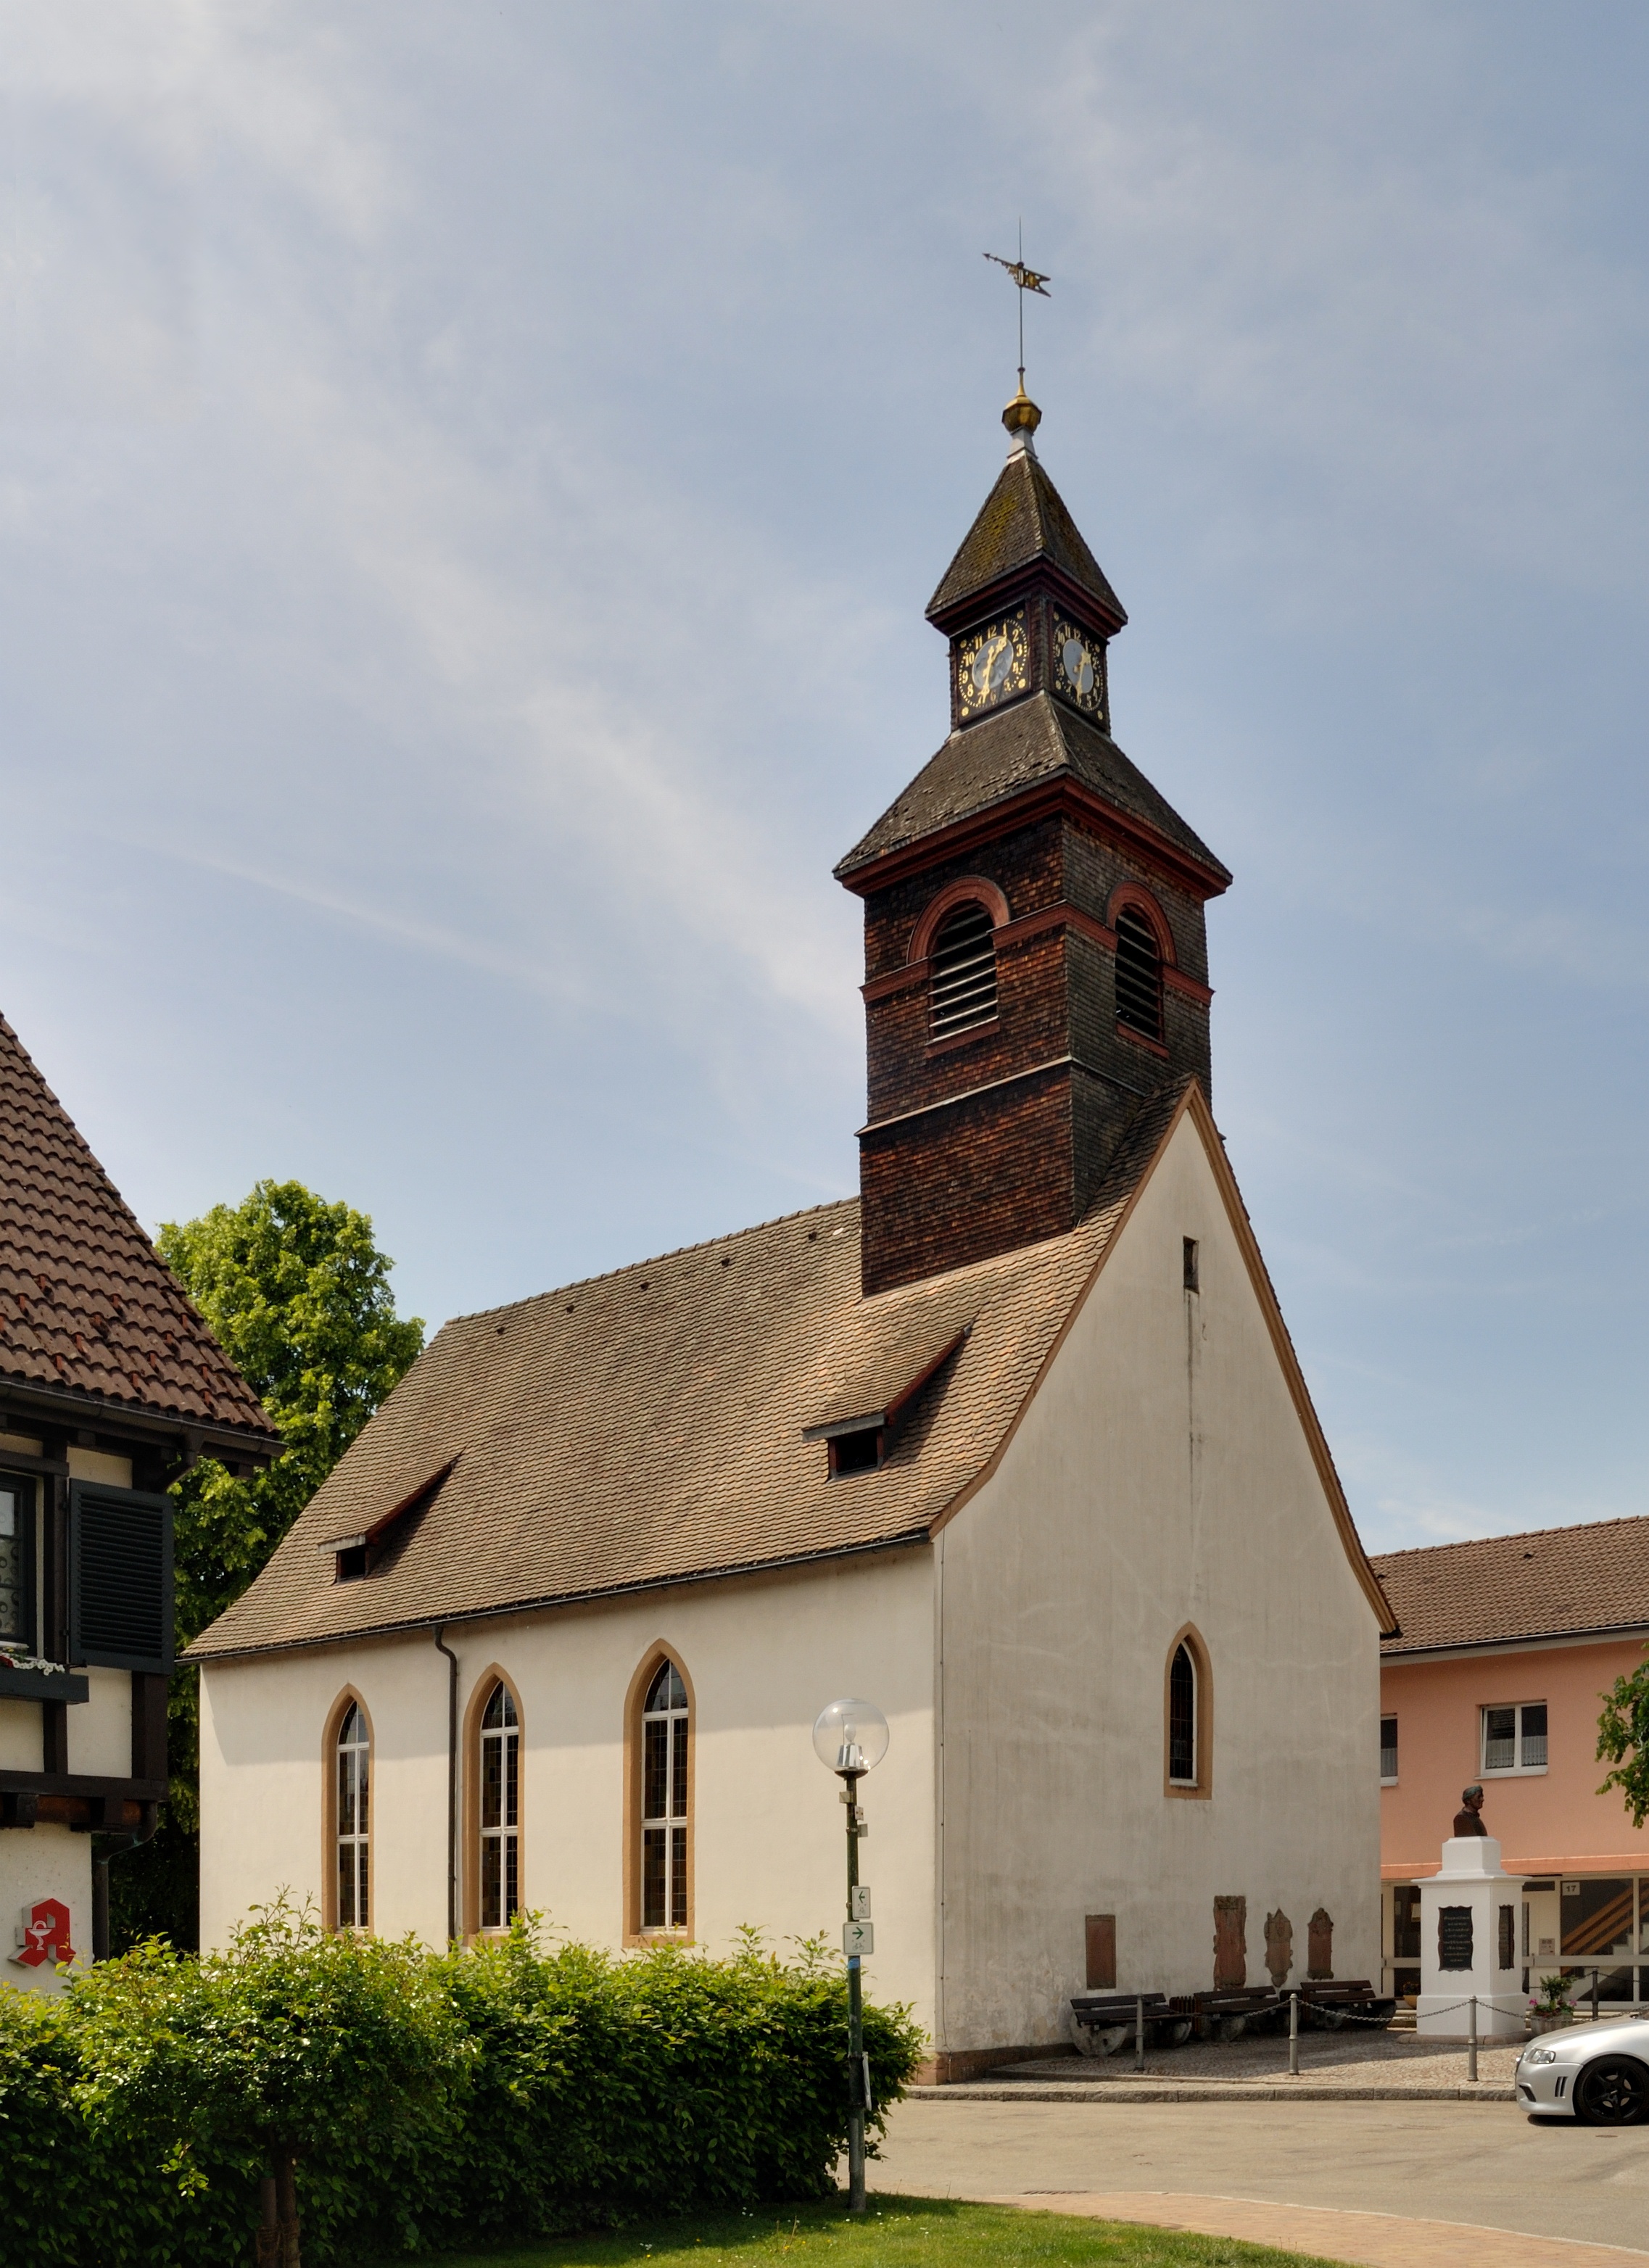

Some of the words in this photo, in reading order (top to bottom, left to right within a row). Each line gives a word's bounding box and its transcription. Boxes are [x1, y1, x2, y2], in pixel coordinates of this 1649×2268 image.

[987, 625, 997, 639] 12
[1002, 622, 1007, 636] 1
[1012, 629, 1020, 643] 2
[1065, 624, 1071, 639] 11
[1073, 626, 1082, 642] 12
[975, 634, 983, 650] 11
[1016, 644, 1023, 657] 3
[1055, 644, 1061, 657] 9
[962, 651, 975, 667] 10
[1092, 655, 1098, 670] 2
[1012, 661, 1020, 674] 4
[1059, 663, 1065, 676] 8
[962, 670, 969, 684] 9
[1094, 674, 1100, 687] 3
[967, 684, 974, 697] 8
[1004, 677, 1012, 692] 5
[1065, 679, 1073, 693] 7
